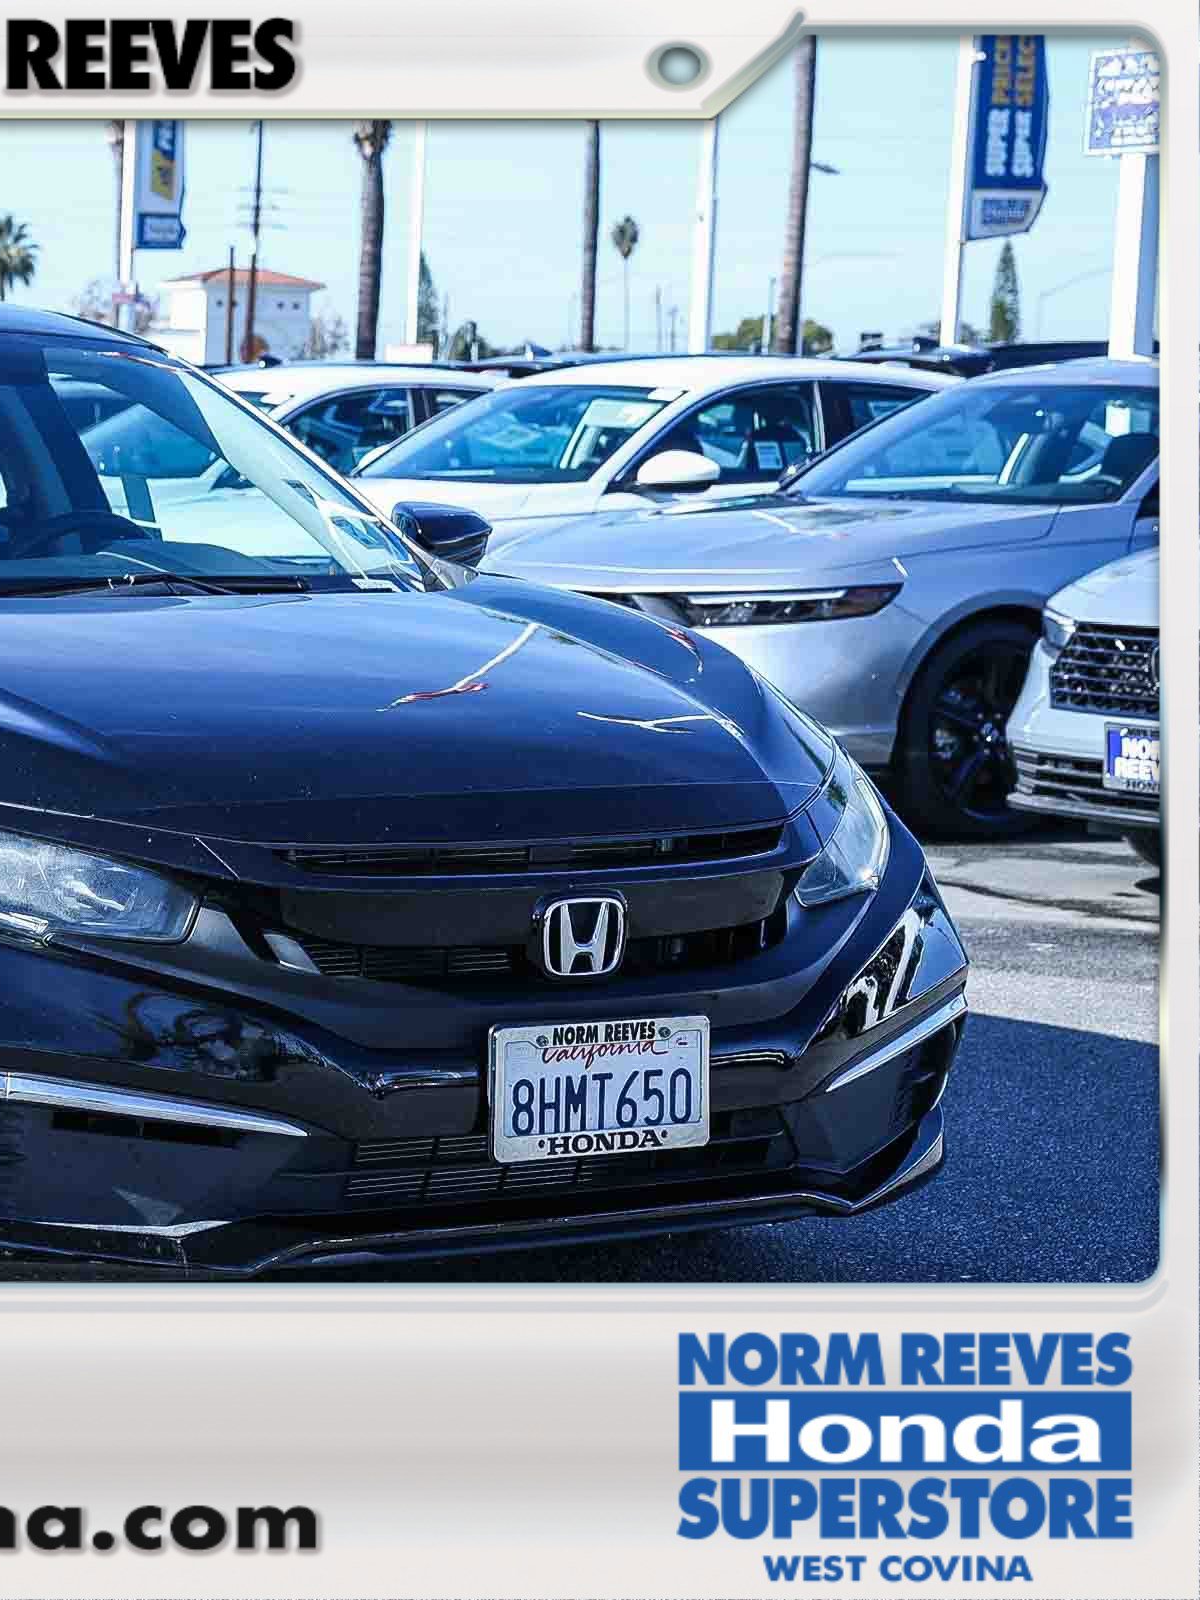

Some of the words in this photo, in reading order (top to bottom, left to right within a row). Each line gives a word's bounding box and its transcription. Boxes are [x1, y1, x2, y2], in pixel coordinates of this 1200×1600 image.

[1121, 736, 1160, 761] NOR
[552, 1024, 600, 1047] NORM
[604, 1021, 656, 1044] REEVES
[511, 1067, 693, 1137] 8HMT650
[546, 1130, 664, 1156] HONDA
